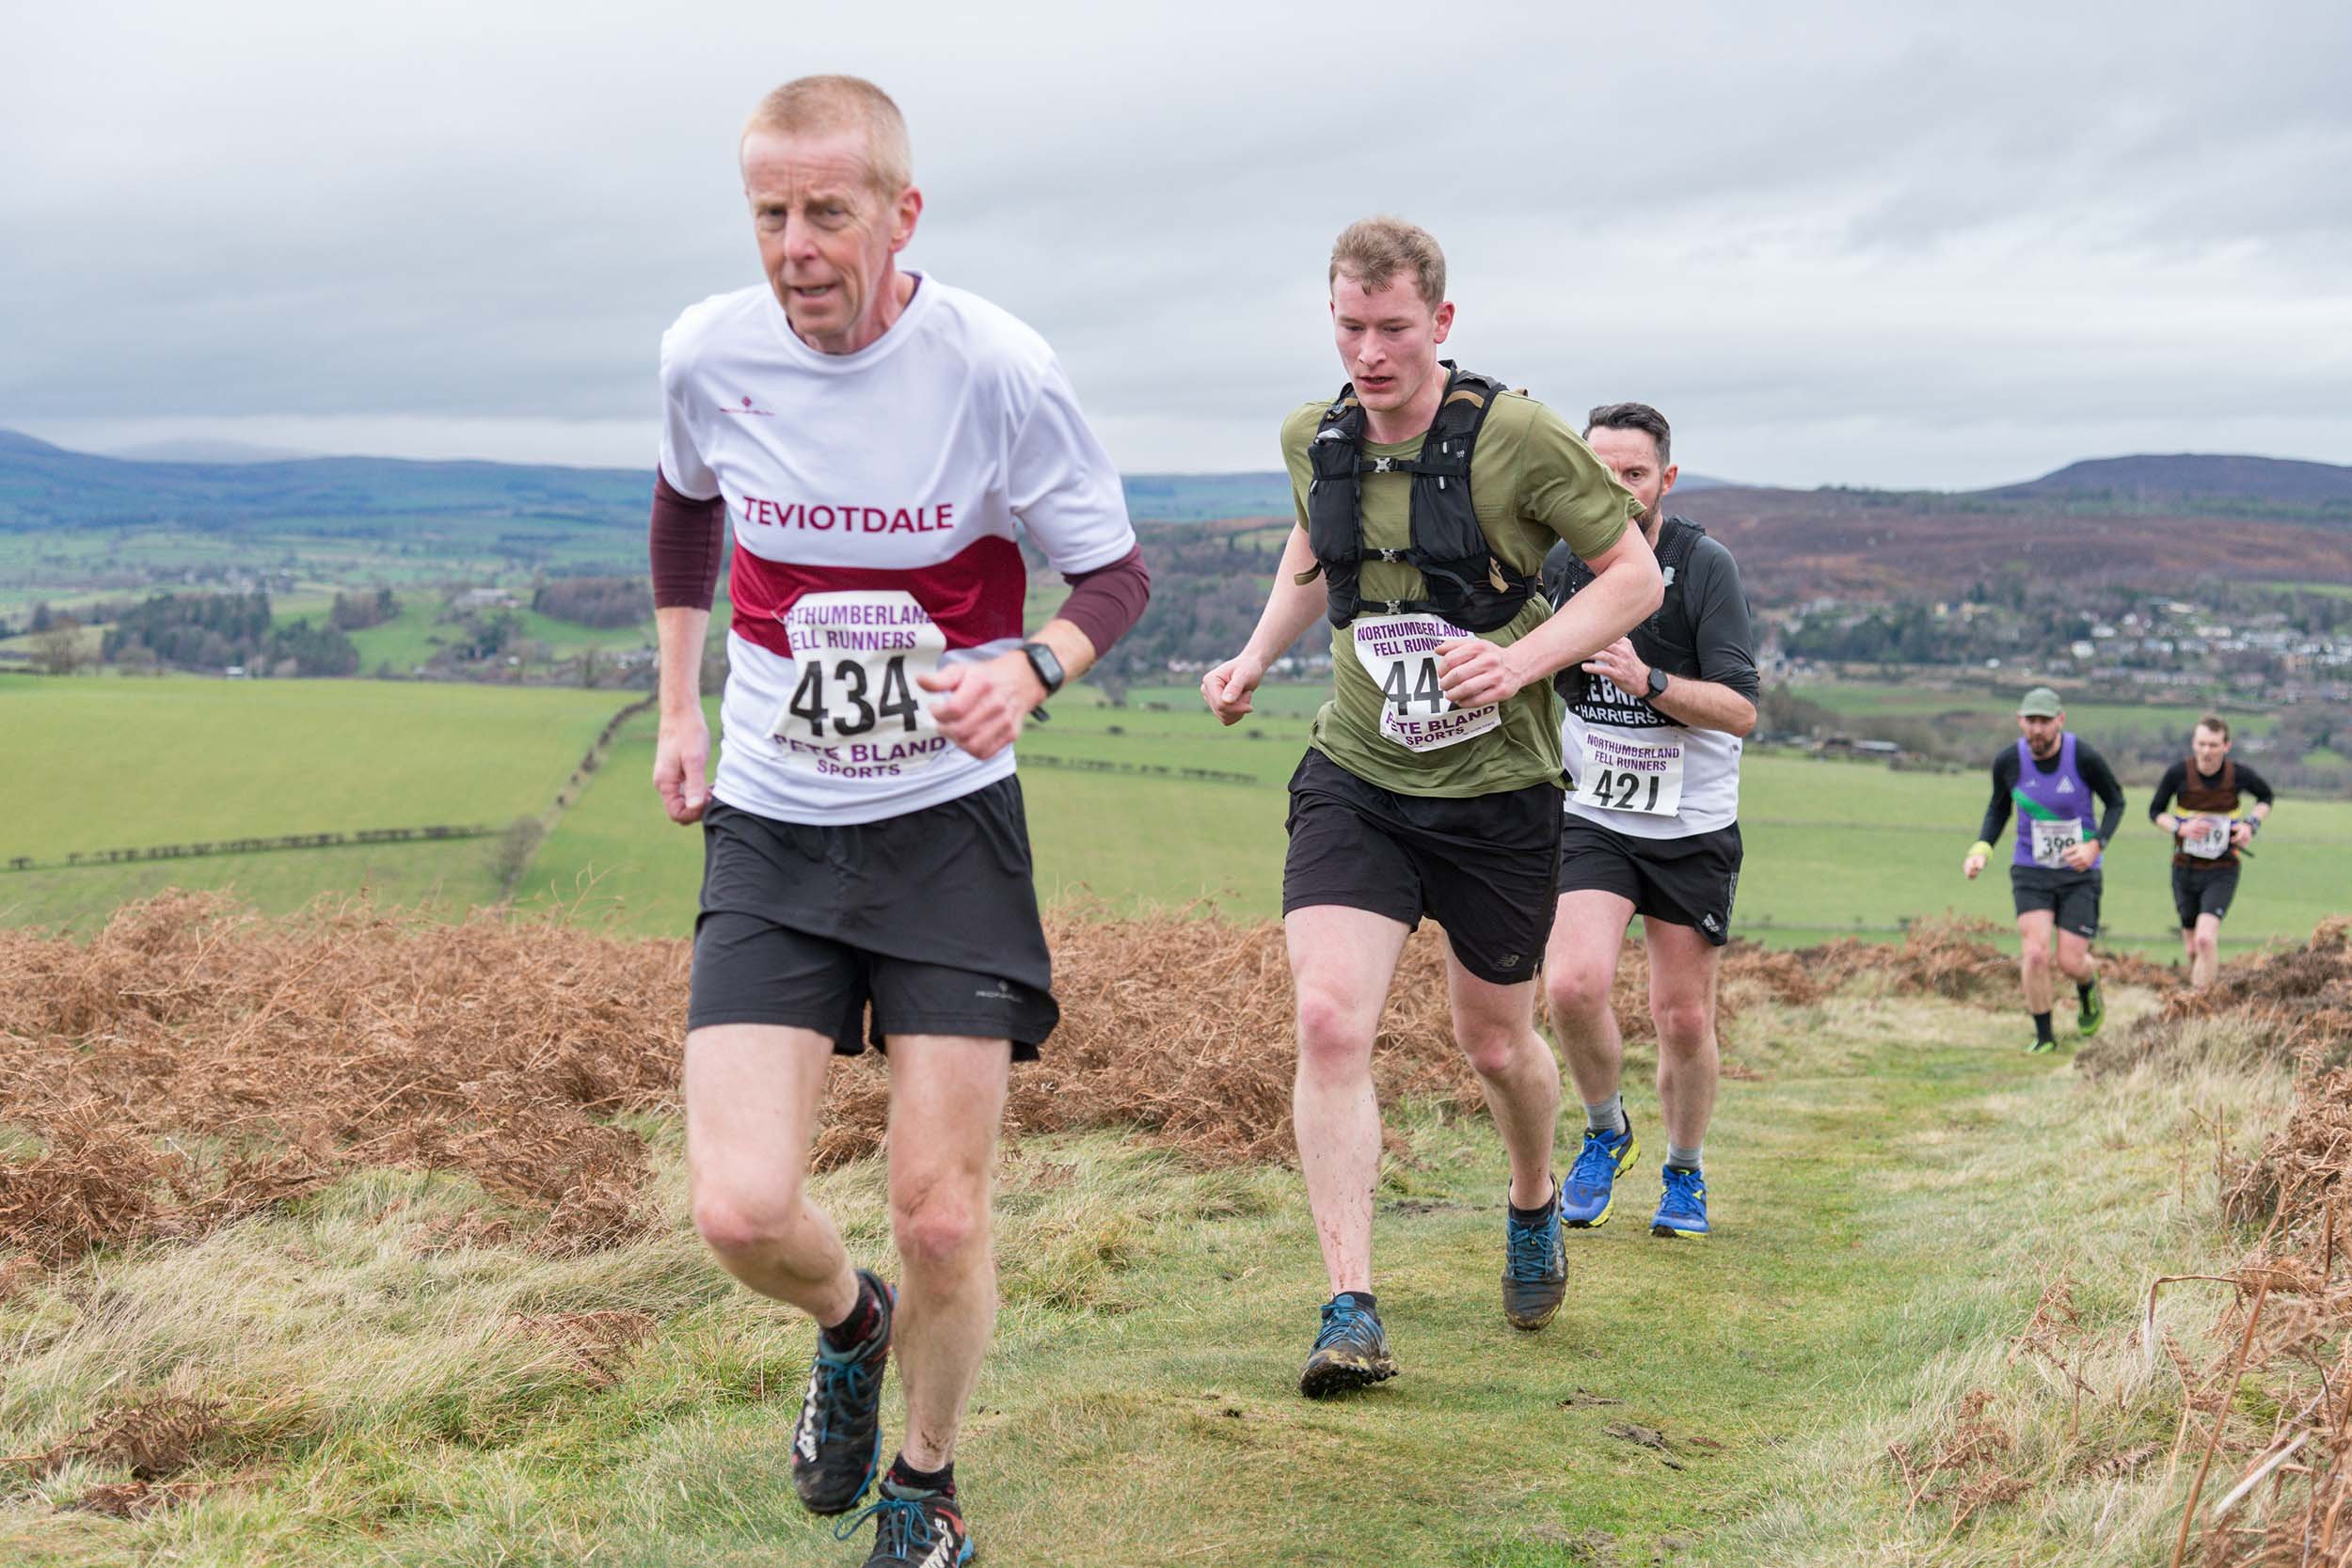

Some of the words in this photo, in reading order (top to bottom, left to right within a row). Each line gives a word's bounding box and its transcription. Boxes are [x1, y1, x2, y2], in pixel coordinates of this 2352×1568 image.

[743, 496, 954, 533] TEVIOTDALE
[787, 605, 932, 626] RTHUMBERLAN
[791, 628, 821, 651] ELL
[827, 630, 917, 651] RUNNERS
[1358, 621, 1469, 641] NORTHUMBERLAND
[1373, 641, 1403, 657] FELL
[1404, 637, 1446, 653] RUNNE
[789, 654, 919, 737] 434
[1383, 657, 1462, 717] 44
[1428, 705, 1496, 733] BLAND
[1580, 704, 1658, 725] HARRIERS
[1405, 725, 1465, 747] SPORTS
[1587, 734, 1680, 759] NORTHUMBERLAND
[773, 734, 841, 762] PETE
[850, 736, 947, 763] BLAND
[817, 758, 901, 779] SPORTS
[1595, 750, 1613, 767] FELL
[1616, 756, 1667, 771] RUNNERS
[1592, 768, 1660, 811] 421
